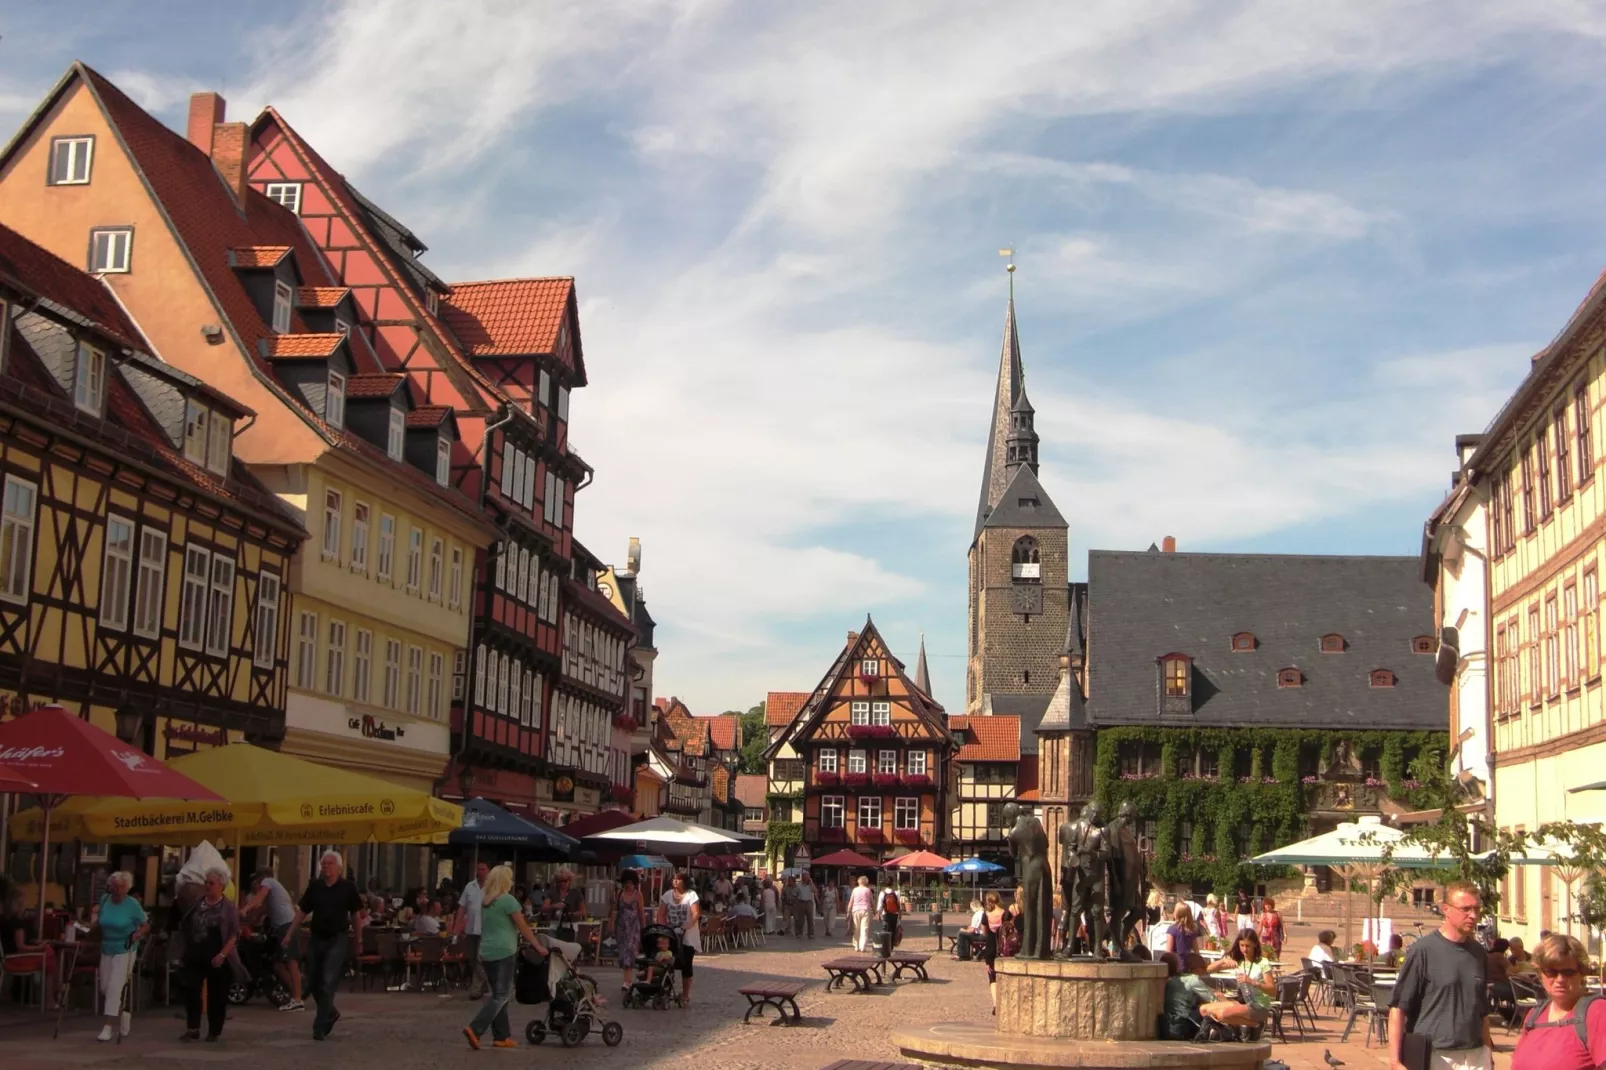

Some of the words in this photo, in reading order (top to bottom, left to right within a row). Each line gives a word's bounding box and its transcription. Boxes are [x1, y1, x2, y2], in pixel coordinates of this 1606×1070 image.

[319, 802, 374, 816] Erlebniscafe
[114, 812, 184, 828] Stadtbäckerei
[187, 809, 234, 824] M.Gelbke
[1337, 837, 1419, 848] Freiberge
